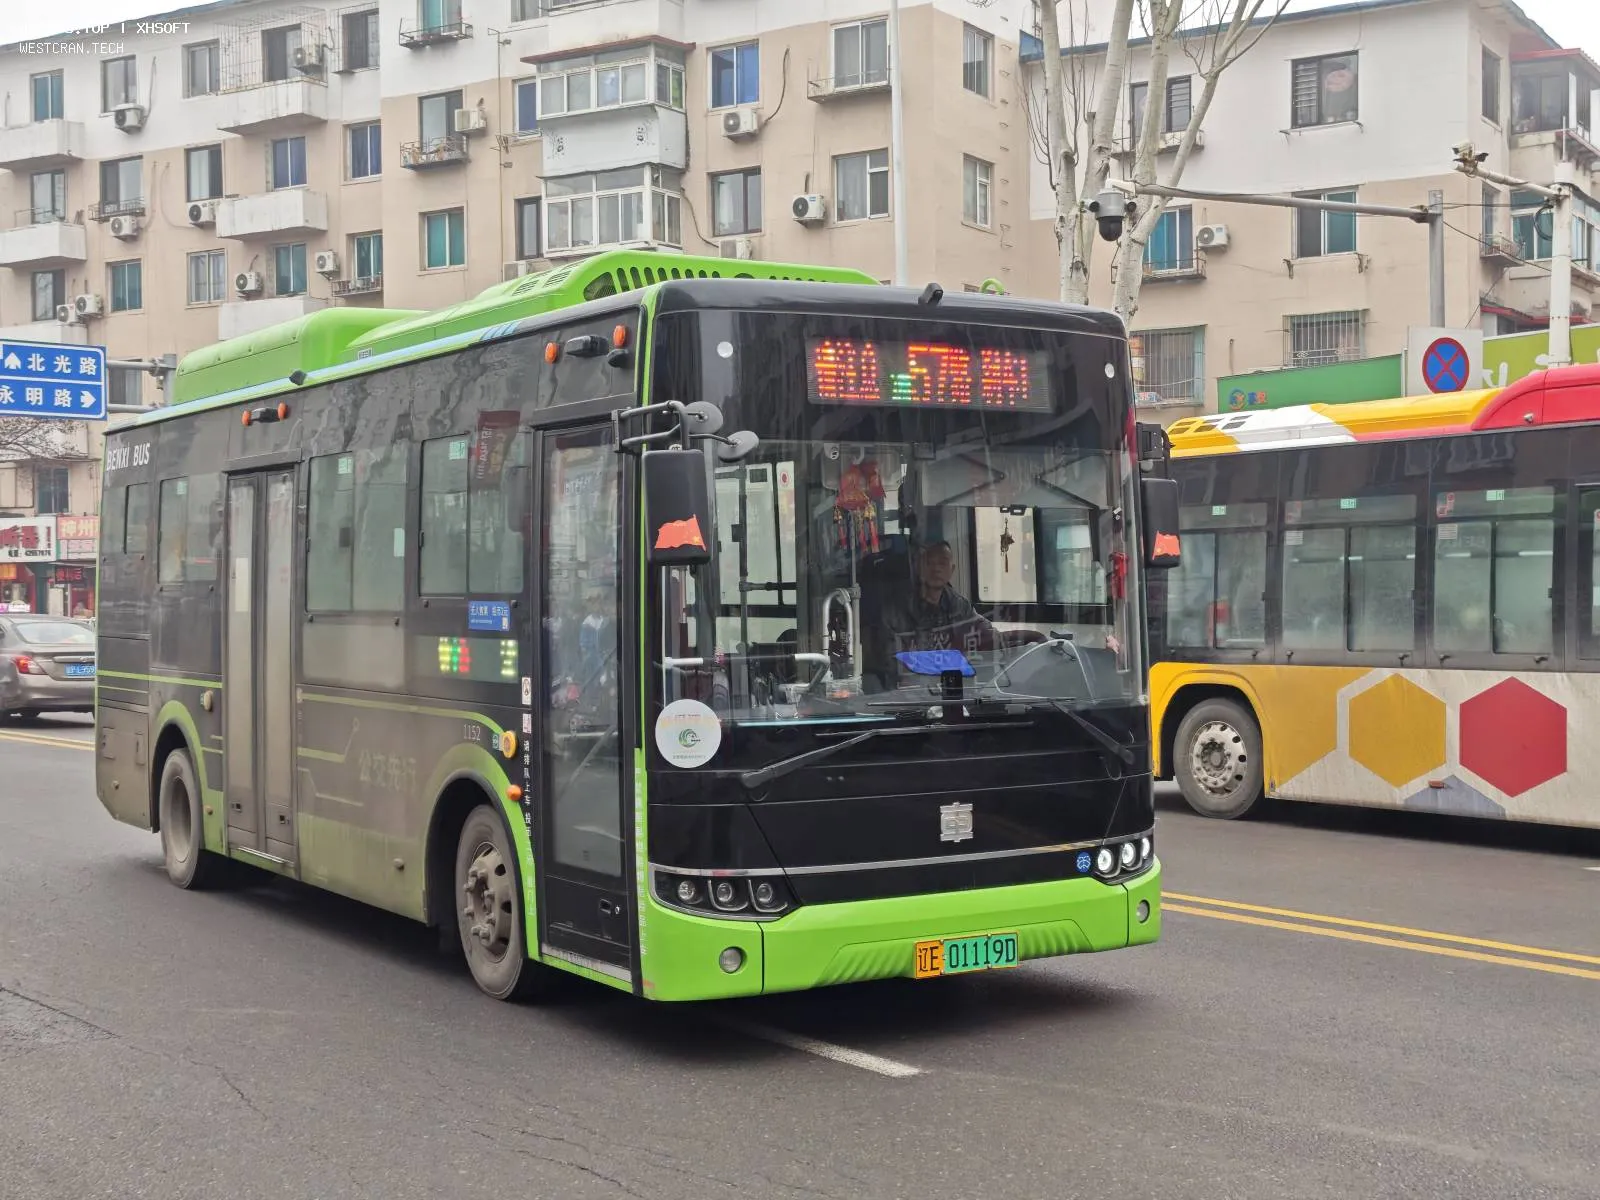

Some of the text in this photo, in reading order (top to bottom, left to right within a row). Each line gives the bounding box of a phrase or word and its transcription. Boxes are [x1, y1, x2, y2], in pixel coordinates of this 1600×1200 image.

[27, 353, 97, 376] 北光路
[0, 385, 73, 408] 永明路
[133, 442, 151, 467] BUS
[463, 723, 481, 741] 1152
[918, 937, 1016, 972] 辽E 01119D
